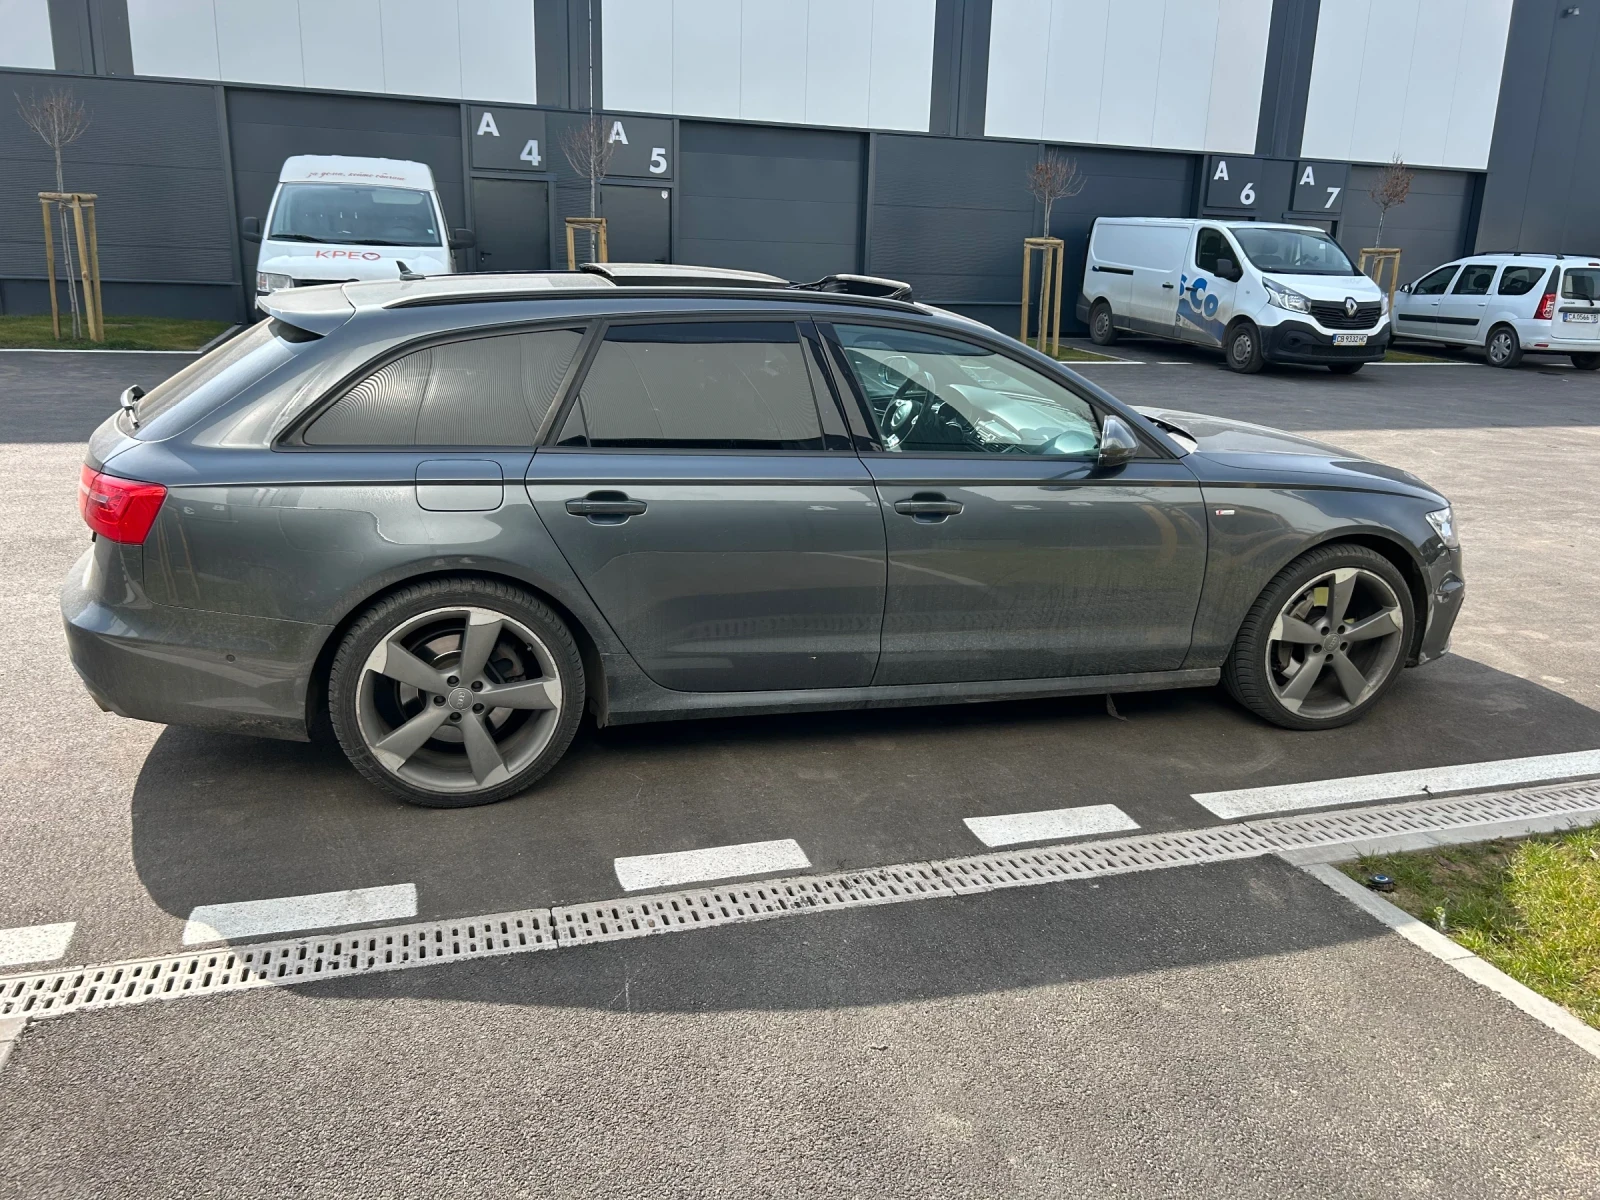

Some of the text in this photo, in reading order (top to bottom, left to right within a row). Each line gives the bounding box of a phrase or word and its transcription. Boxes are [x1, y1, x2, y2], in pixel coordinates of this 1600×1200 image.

[477, 112, 500, 137] A
[608, 121, 629, 145] A
[519, 140, 542, 166] 4
[649, 148, 668, 174] 5
[1213, 160, 1230, 181] A
[1299, 166, 1316, 186] A
[1240, 182, 1256, 206] 6
[1324, 187, 1341, 209] 7
